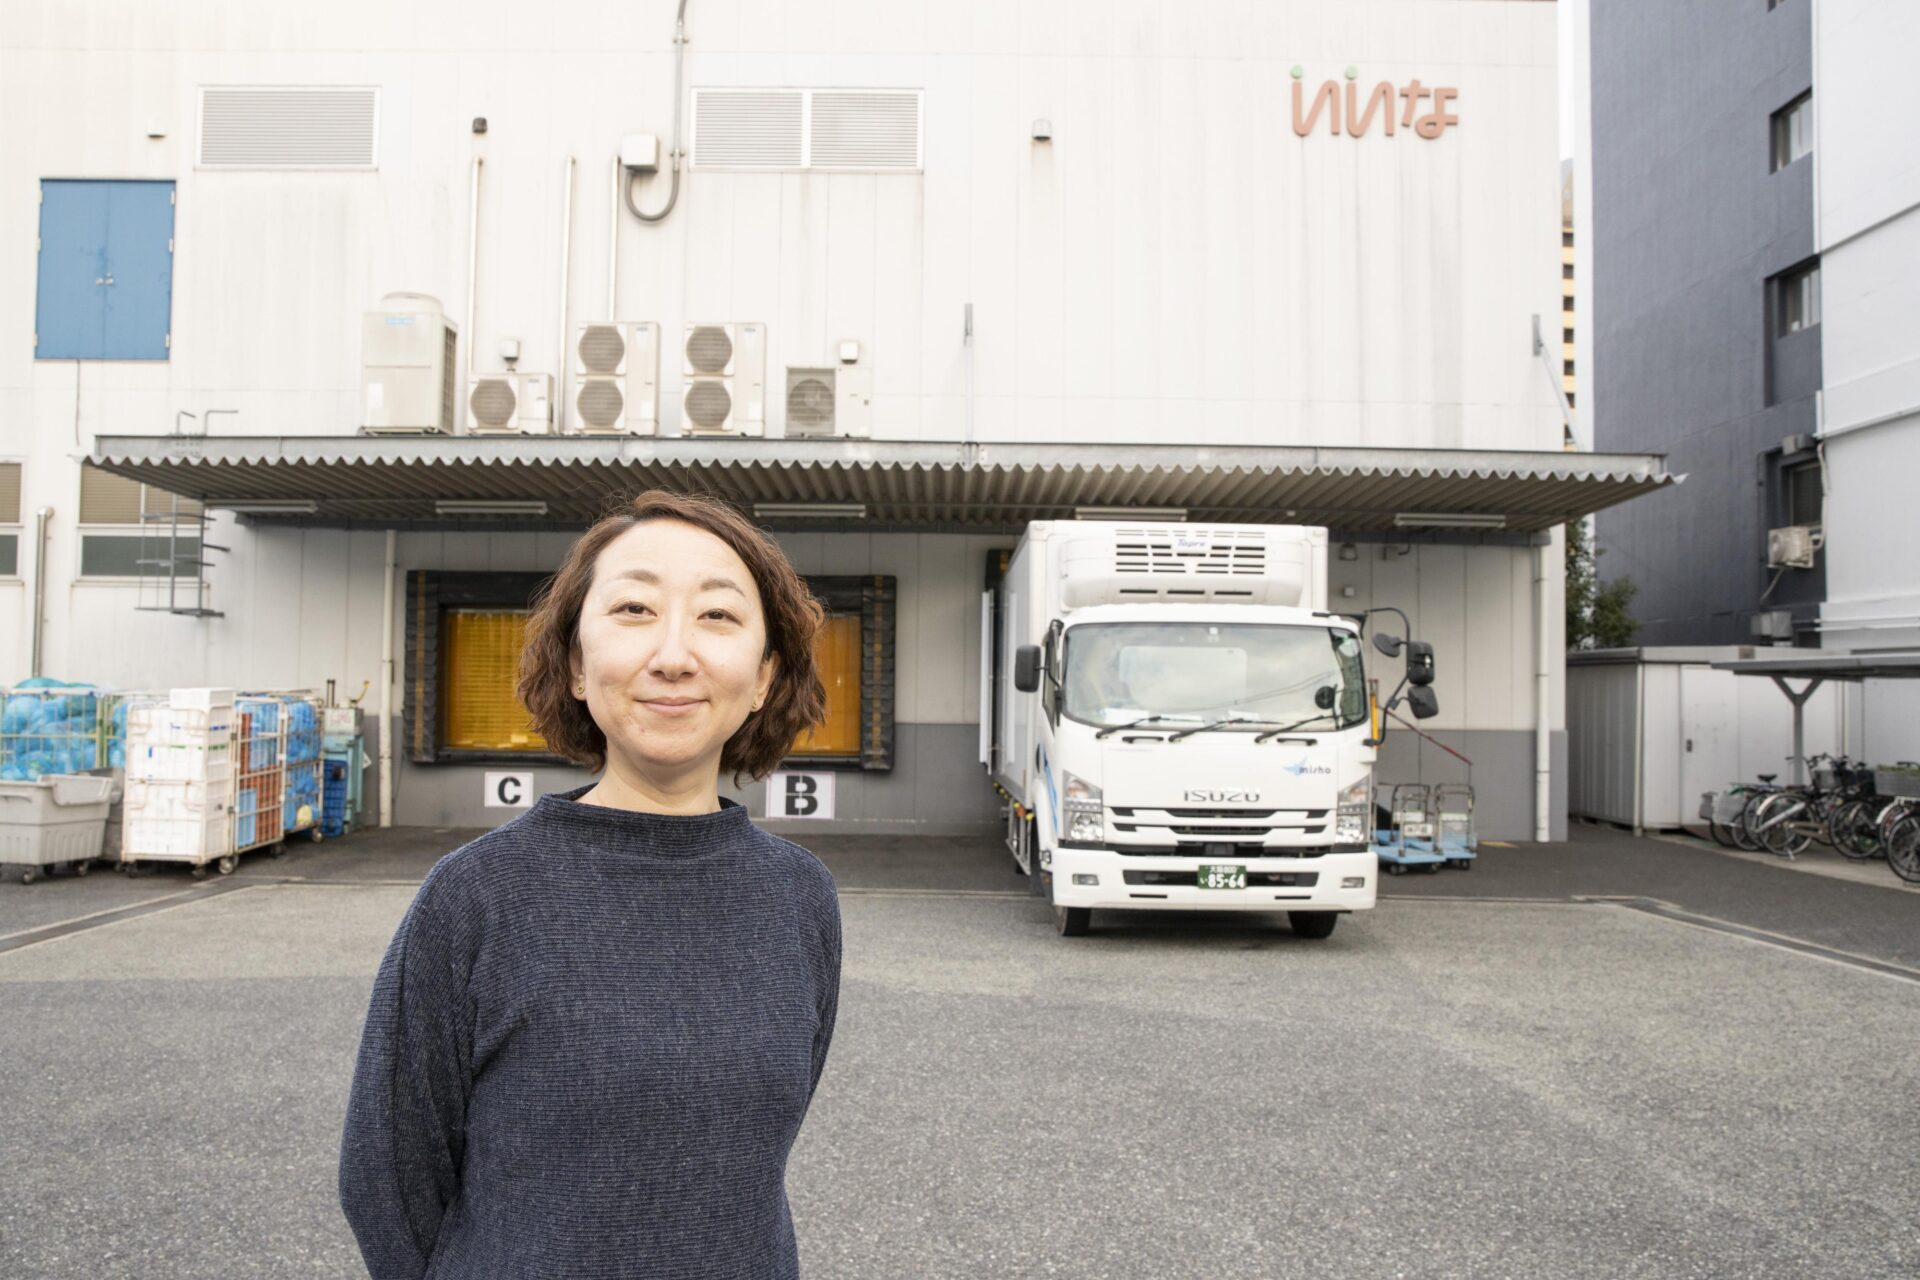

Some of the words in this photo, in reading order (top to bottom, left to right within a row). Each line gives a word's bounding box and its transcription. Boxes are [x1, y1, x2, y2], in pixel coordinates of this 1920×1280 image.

[1290, 64, 1459, 140] いいな
[497, 776, 522, 805] C
[785, 775, 819, 816] B
[1183, 789, 1260, 803] ISUZU
[1208, 874, 1245, 888] 85-64
